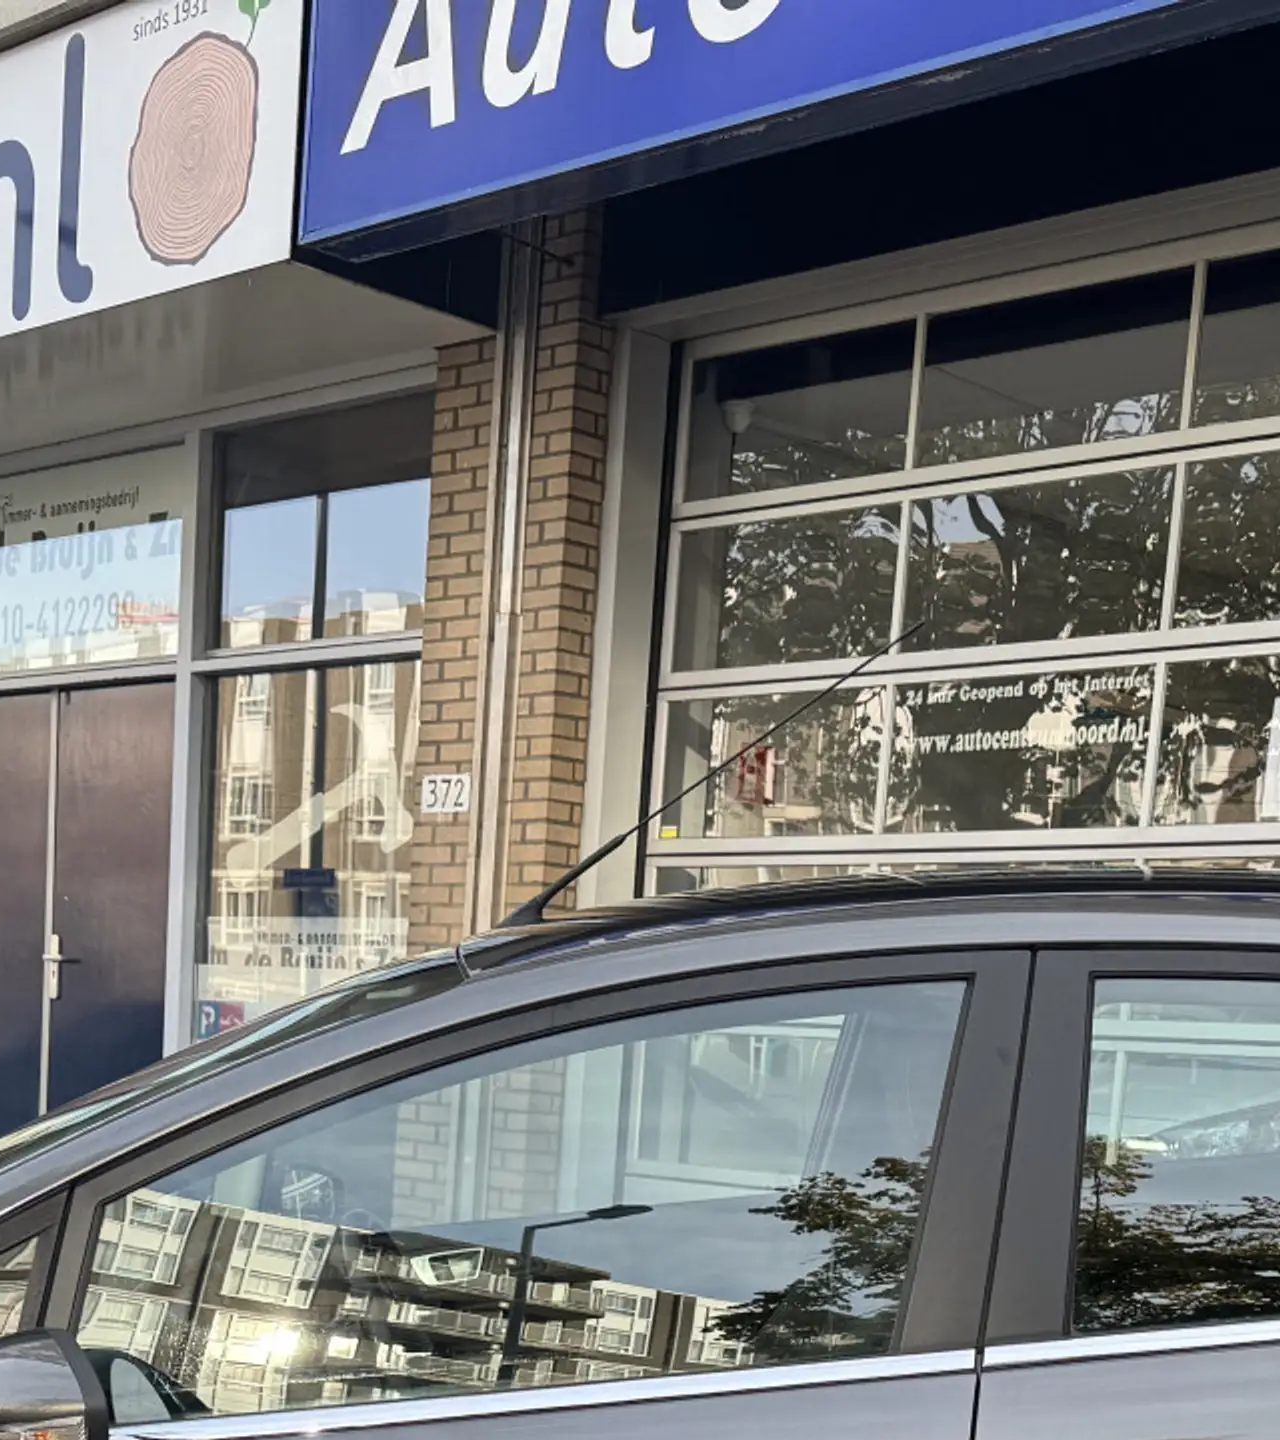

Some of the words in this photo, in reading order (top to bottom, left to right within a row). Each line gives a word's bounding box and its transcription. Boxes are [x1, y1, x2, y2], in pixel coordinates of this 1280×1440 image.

[132, 9, 170, 41] sinds
[173, 0, 209, 26] 1931
[31, 520, 114, 582] Bruijn
[906, 689, 923, 707] 24
[960, 681, 1023, 703] Geopend
[1029, 682, 1049, 699] op
[1084, 673, 1150, 693] Internet
[426, 778, 465, 808] 372
